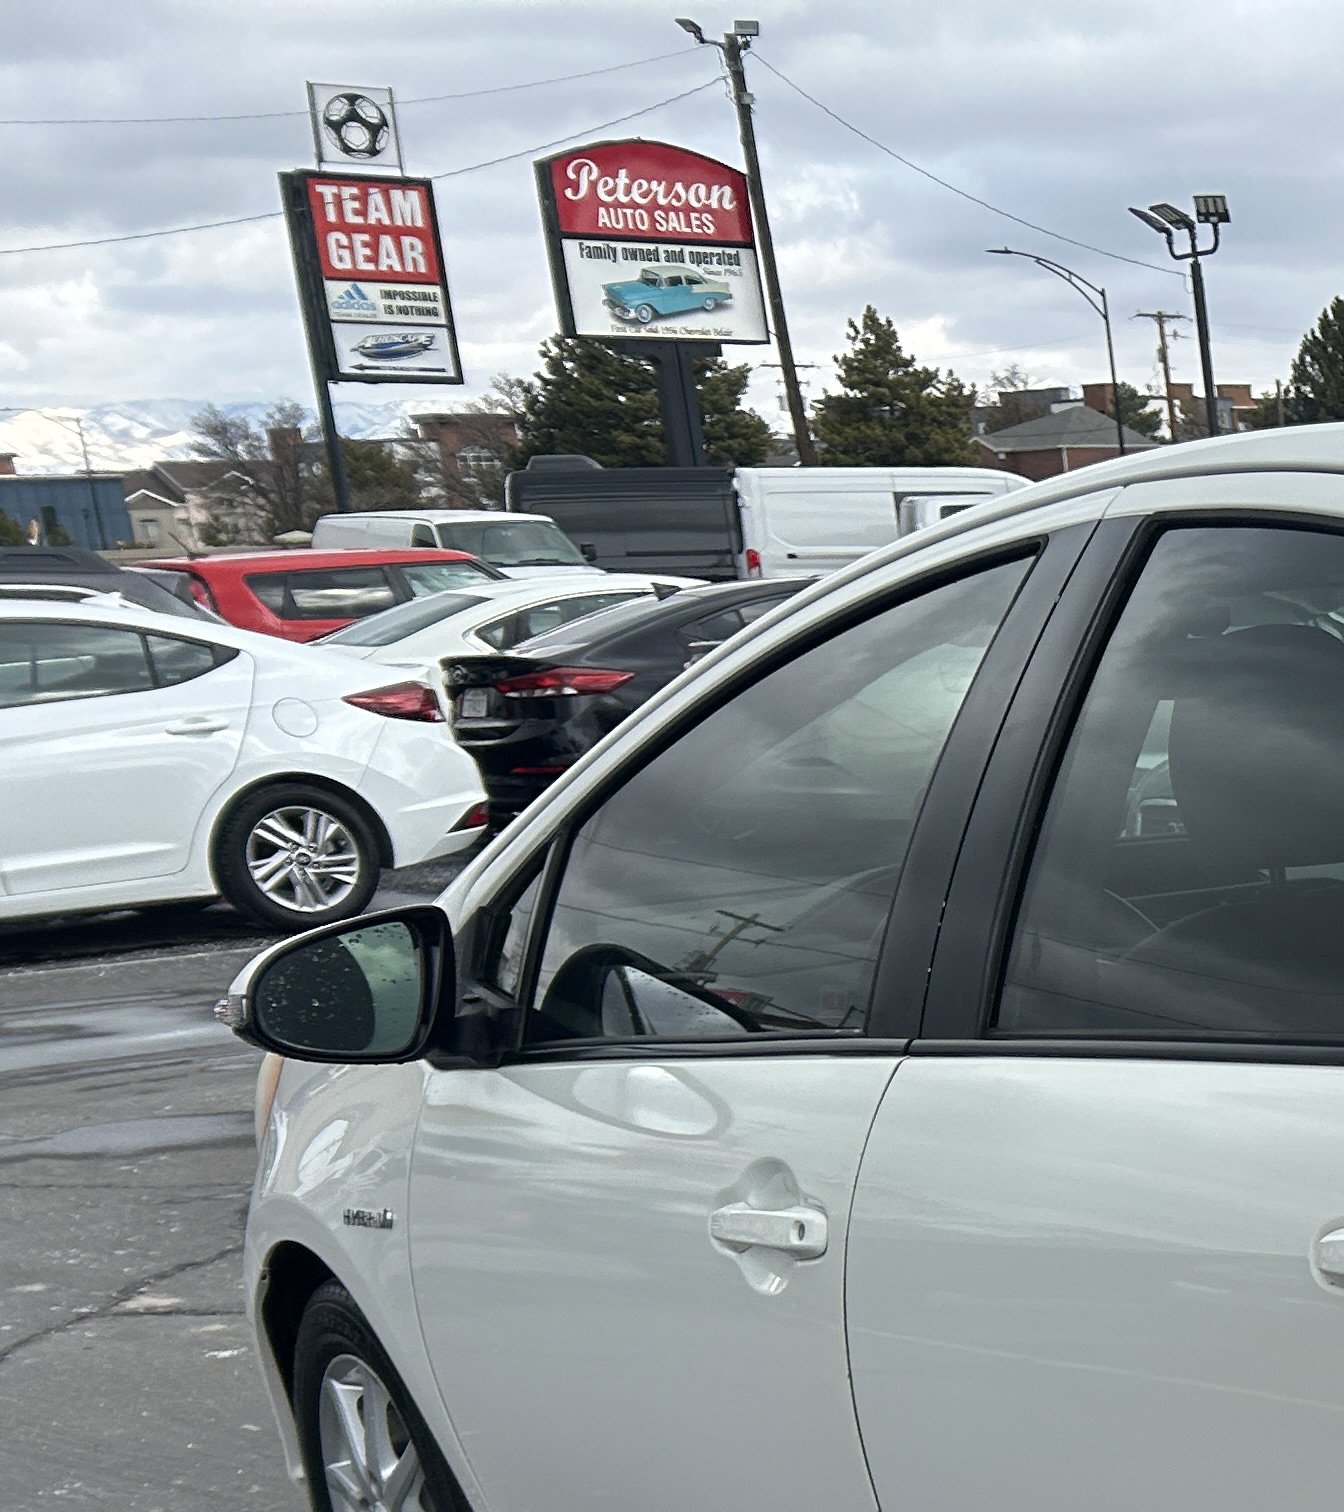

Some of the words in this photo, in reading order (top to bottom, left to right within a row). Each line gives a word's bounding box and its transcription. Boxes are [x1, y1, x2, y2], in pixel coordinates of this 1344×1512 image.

[564, 158, 737, 210] Peterson
[315, 185, 424, 228] TEAM
[598, 207, 650, 232] AUTO
[654, 210, 715, 235] SALES
[326, 231, 427, 273] GEAR
[578, 242, 617, 263] Family
[621, 246, 660, 263] owned
[664, 247, 685, 263] and
[689, 250, 741, 267] operated
[331, 300, 377, 311] adidas
[380, 289, 439, 303] IMPOSSIBLE
[384, 304, 395, 315] IS
[396, 305, 439, 317] NOTHING
